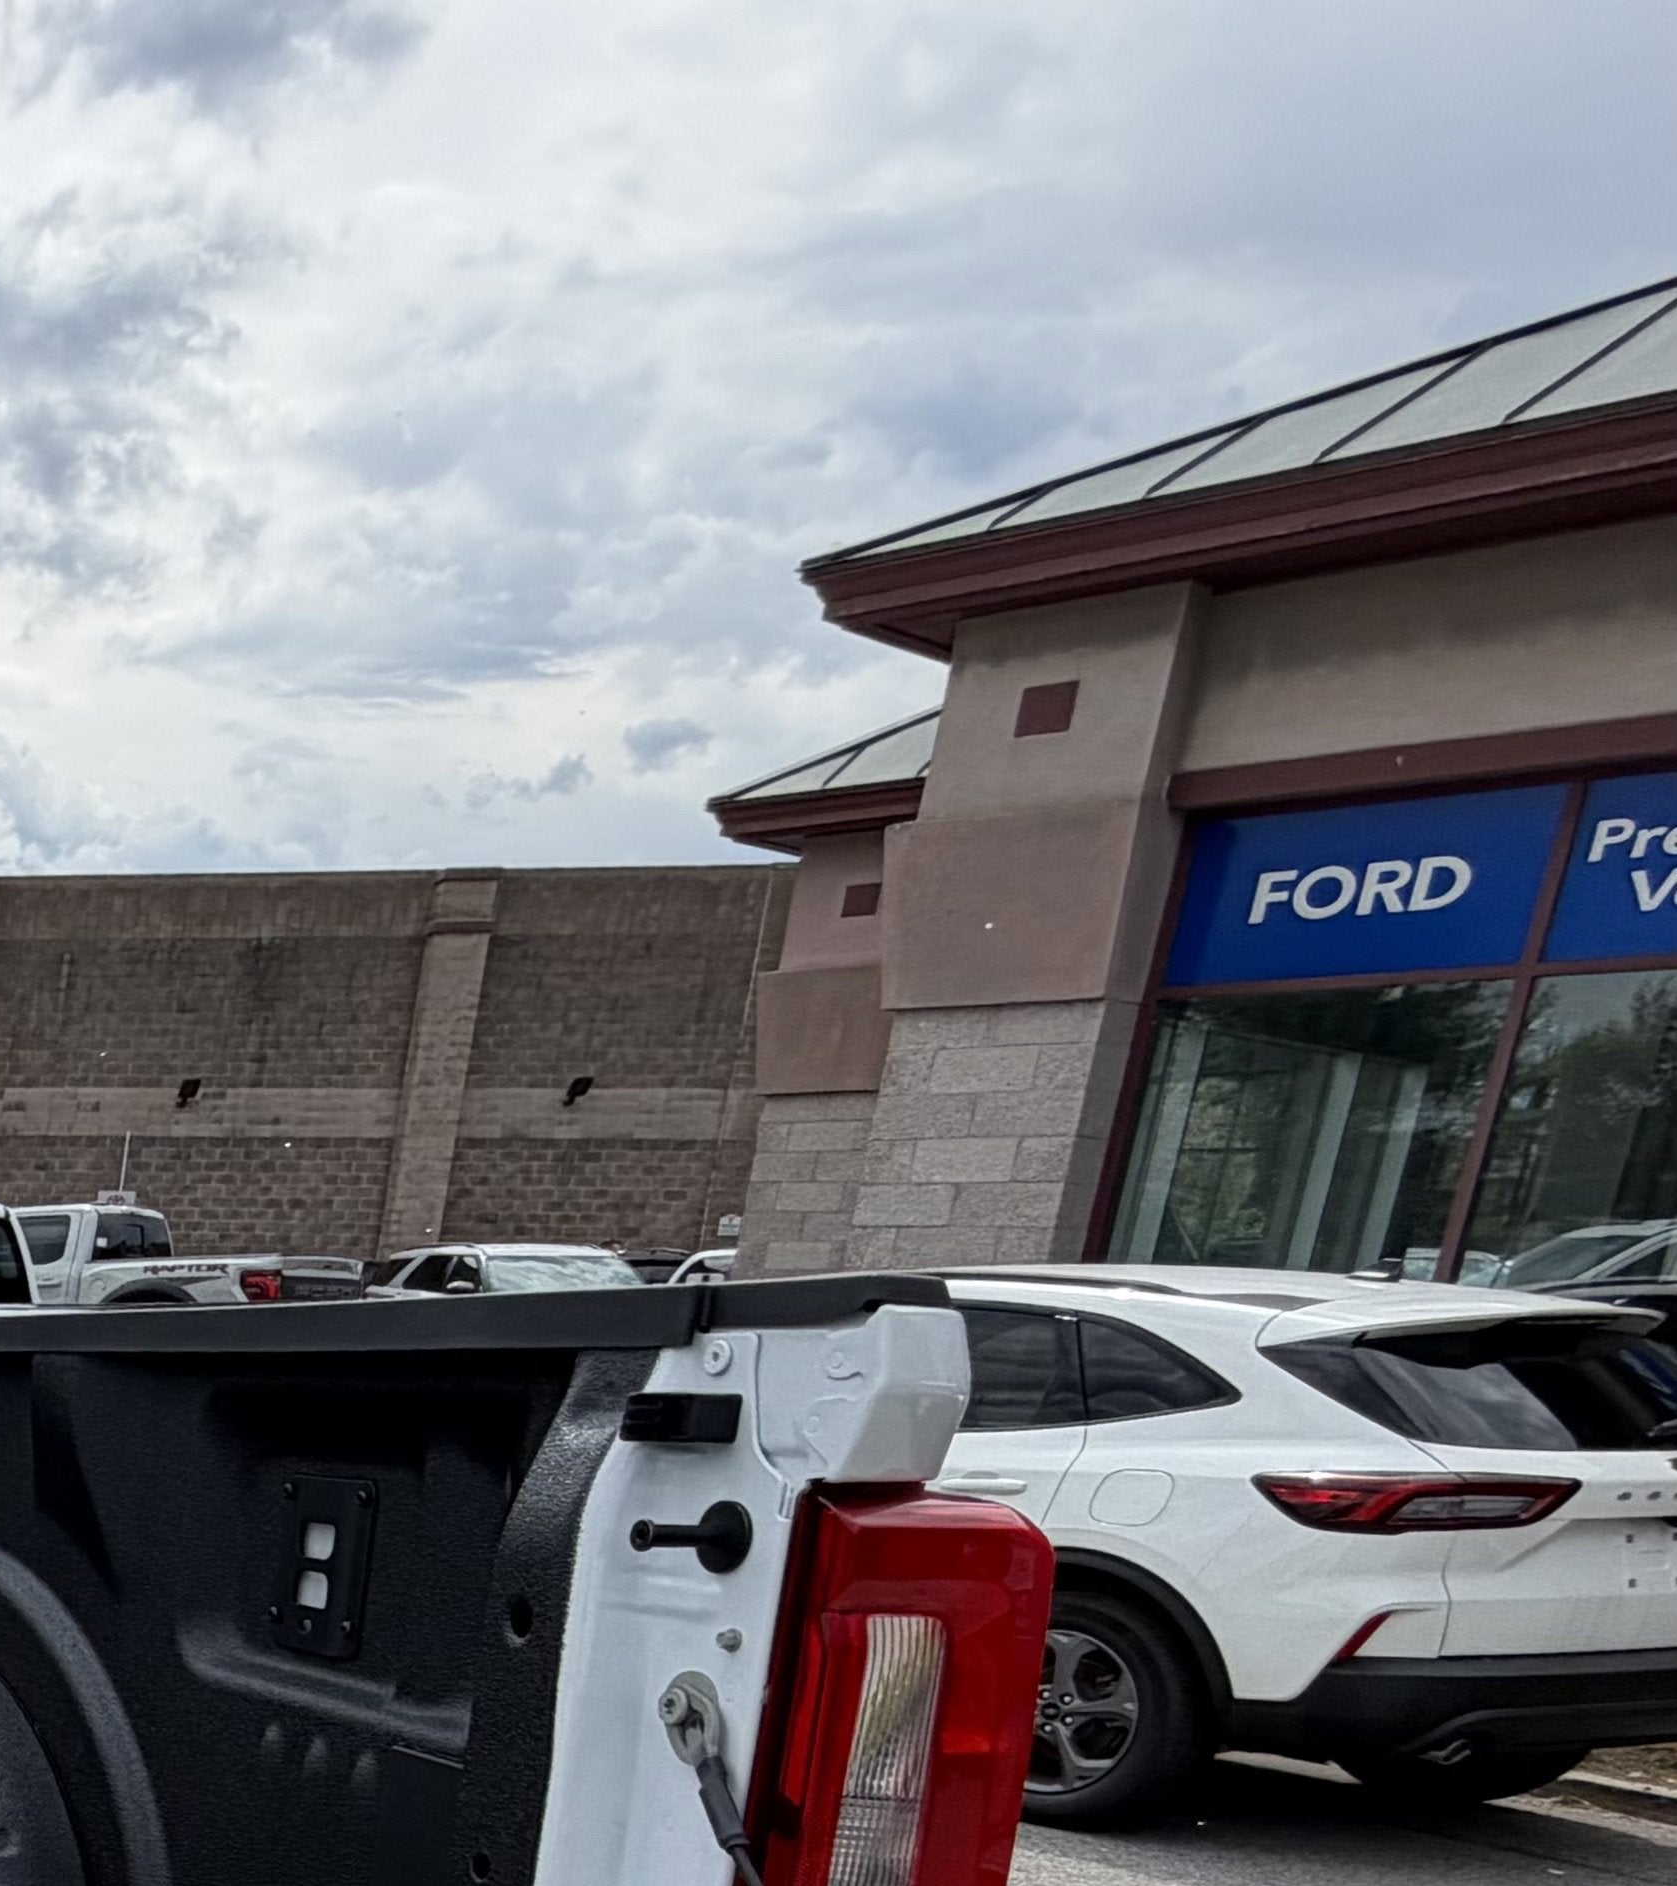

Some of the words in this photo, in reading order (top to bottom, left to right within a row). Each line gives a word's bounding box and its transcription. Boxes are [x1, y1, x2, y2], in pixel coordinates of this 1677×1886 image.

[1247, 855, 1472, 925] FORD
[1631, 868, 1677, 911] V
[143, 1264, 229, 1276] RAPTOR
